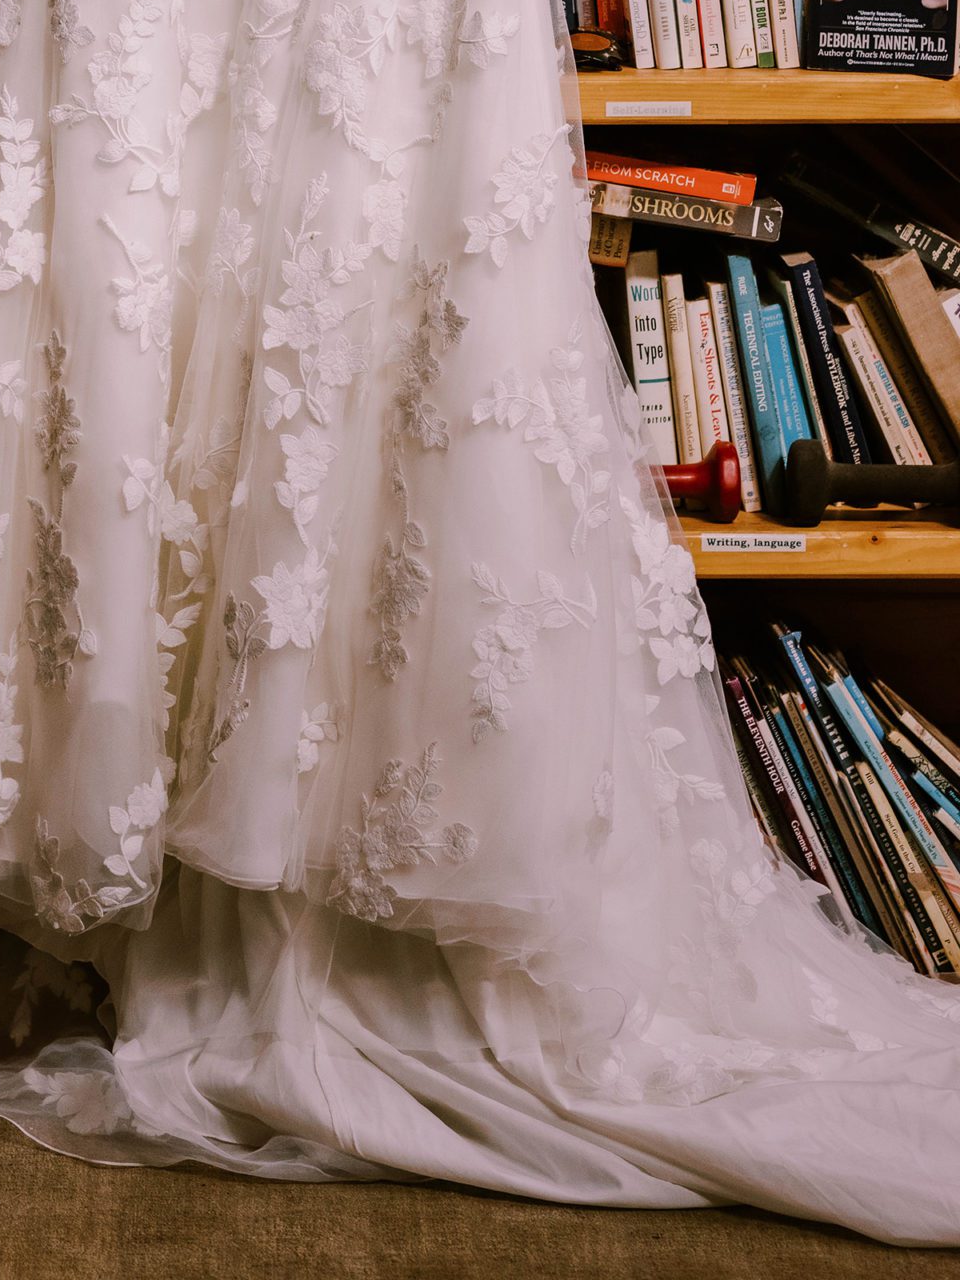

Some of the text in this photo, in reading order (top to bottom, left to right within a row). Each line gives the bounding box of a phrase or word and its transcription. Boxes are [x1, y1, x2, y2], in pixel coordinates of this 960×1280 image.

[756, 8, 767, 28] BOOK
[820, 32, 947, 52] DEBORAH TANNEN, Ph.D.
[593, 162, 695, 188] FROM SCRATCH
[598, 191, 734, 226] MUSHROOMS
[630, 281, 662, 302] Word
[635, 316, 657, 332] into
[636, 343, 664, 366] Type
[803, 270, 856, 446] The Associated Press STYLEBOOK and Libel
[706, 538, 802, 549] Writing, language
[738, 697, 784, 795] THE ELEVENTH HOUR
[791, 820, 816, 871] Graeme Base
